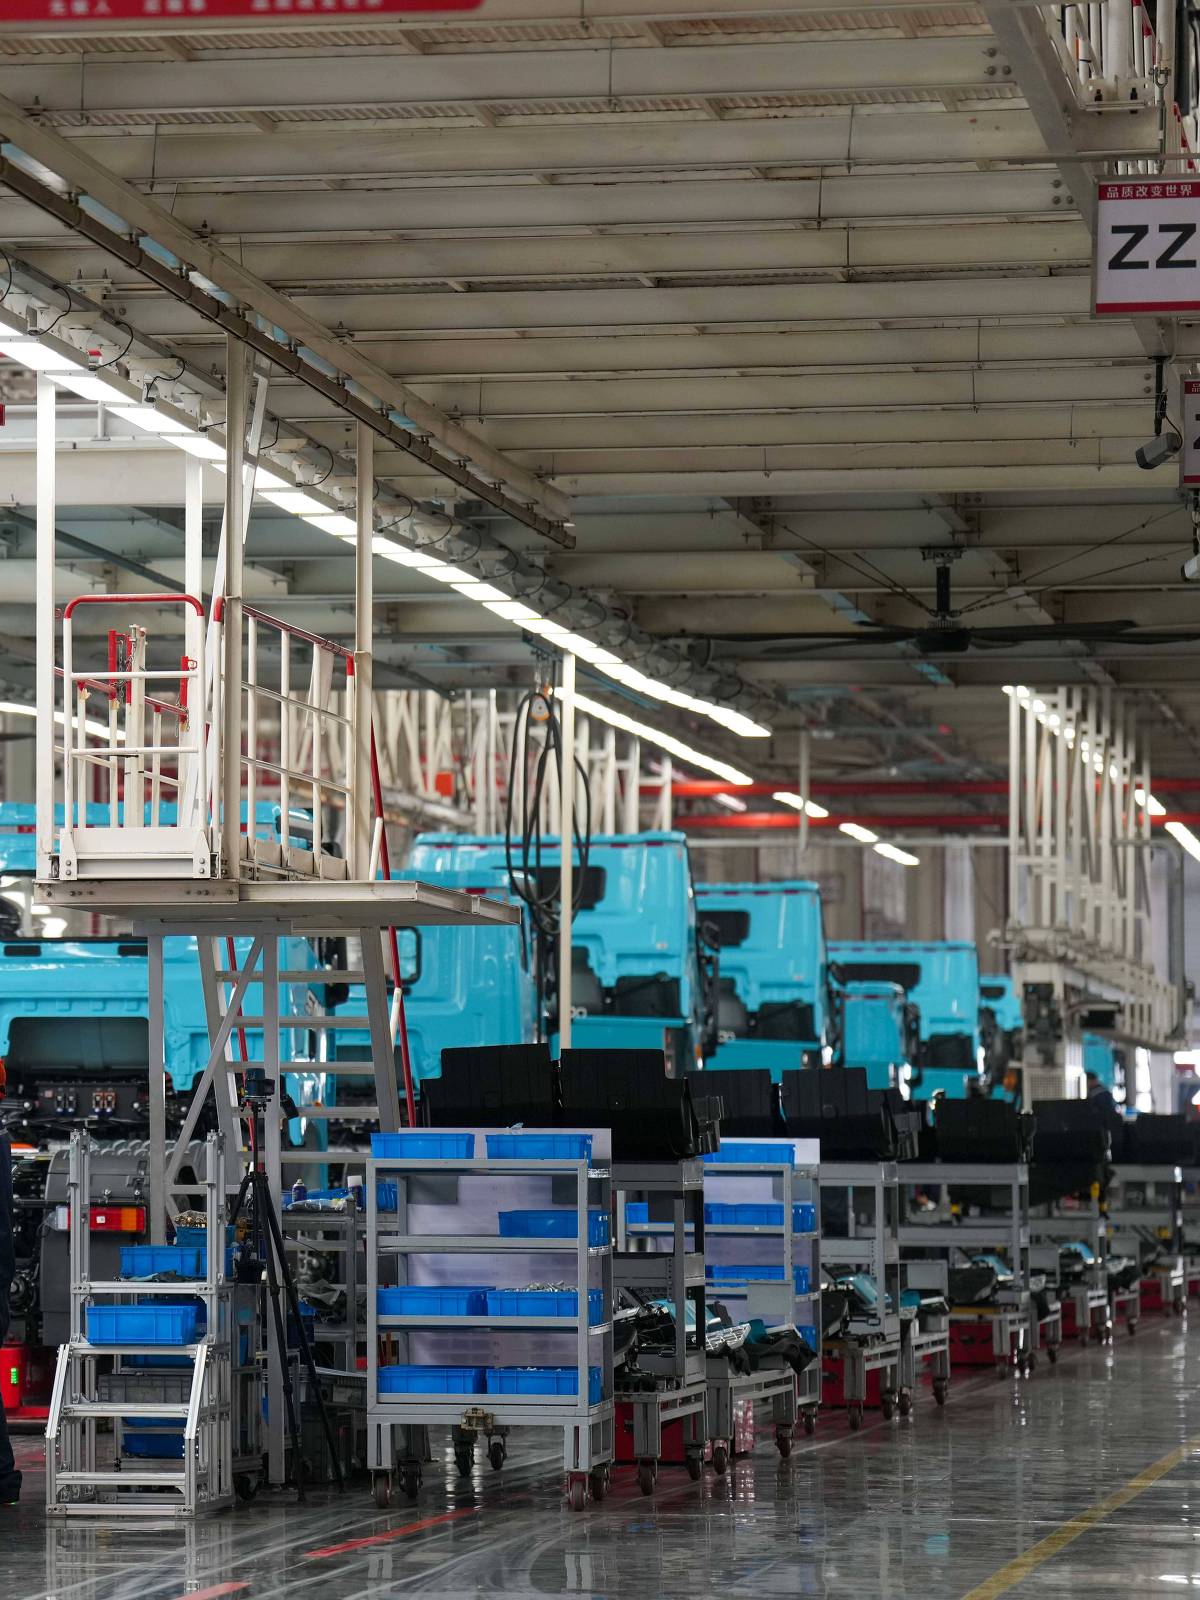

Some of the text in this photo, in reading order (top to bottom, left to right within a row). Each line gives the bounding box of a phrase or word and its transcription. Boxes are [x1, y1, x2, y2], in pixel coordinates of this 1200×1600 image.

[1107, 184, 1192, 198] 品质改变世界
[1108, 223, 1197, 270] ZZ
